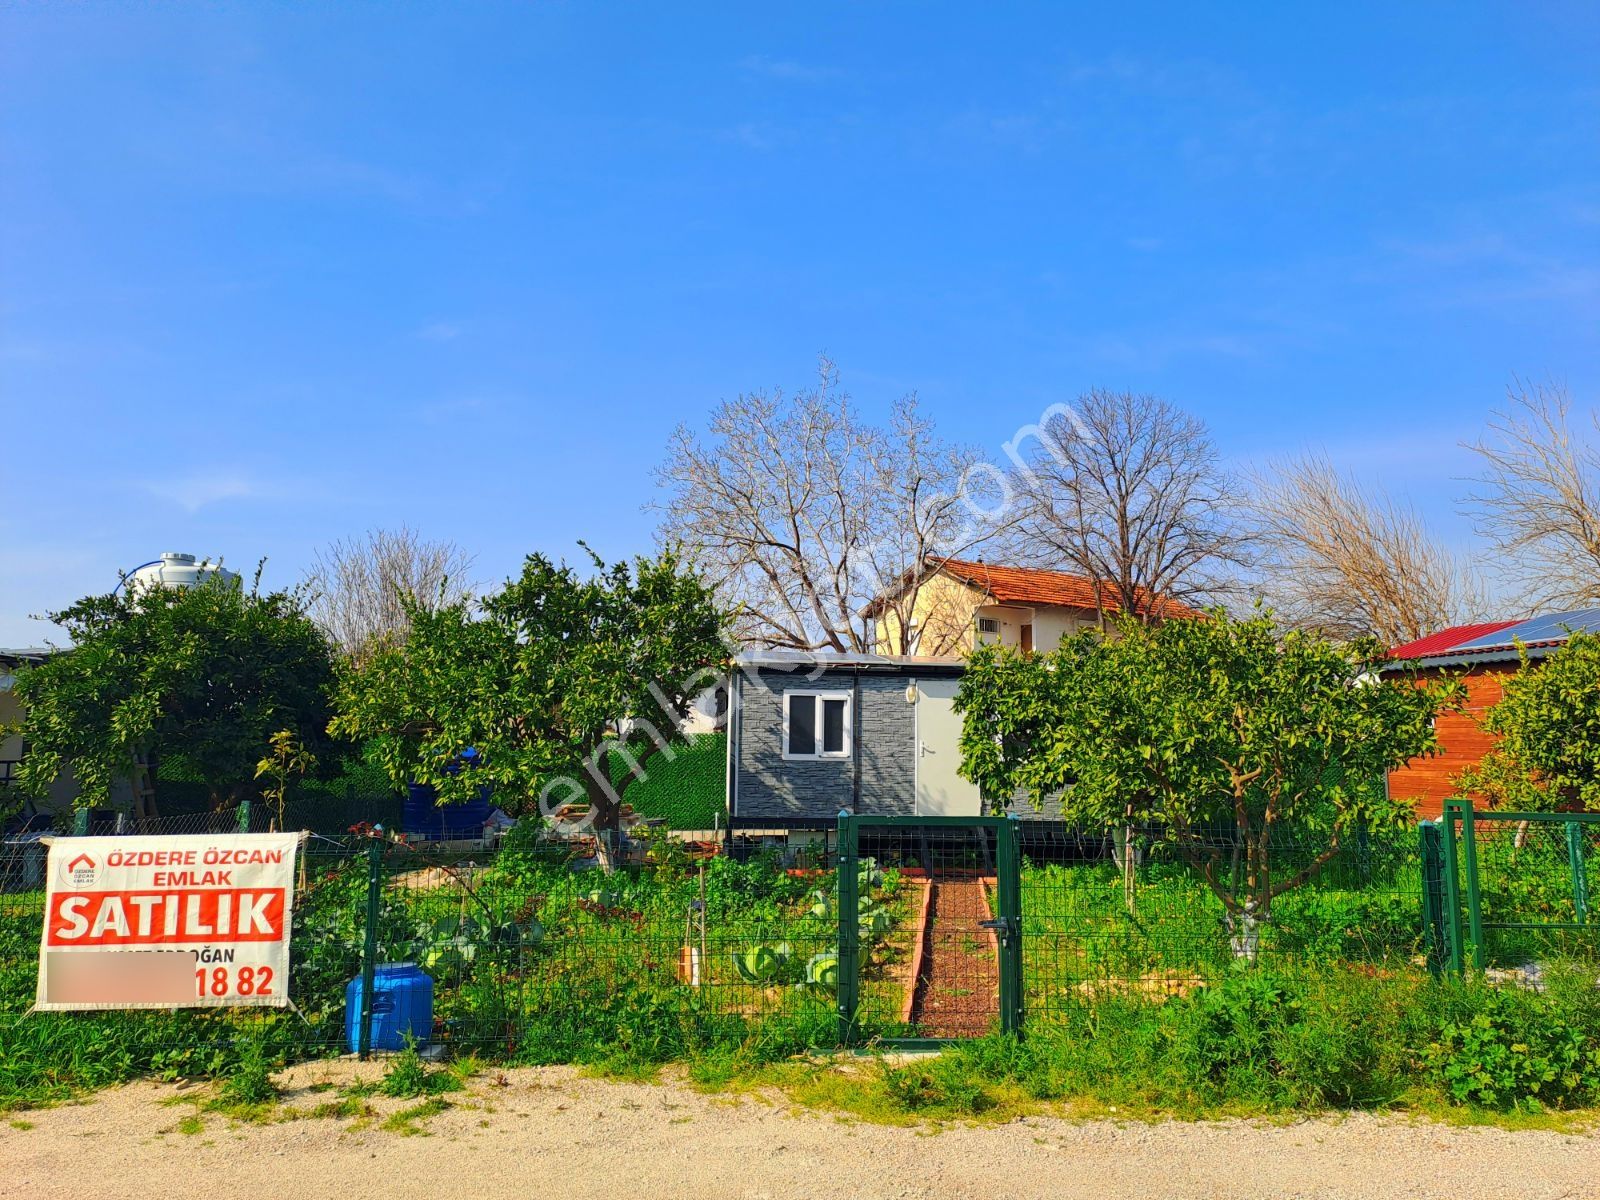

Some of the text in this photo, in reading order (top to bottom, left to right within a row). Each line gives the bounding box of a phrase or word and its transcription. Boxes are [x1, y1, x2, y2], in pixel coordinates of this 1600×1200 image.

[107, 847, 282, 867] ÖZDERE ÖZCAN
[153, 870, 232, 887] EMLAK
[55, 893, 277, 940] SATILIK
[195, 965, 274, 996] 18 82
